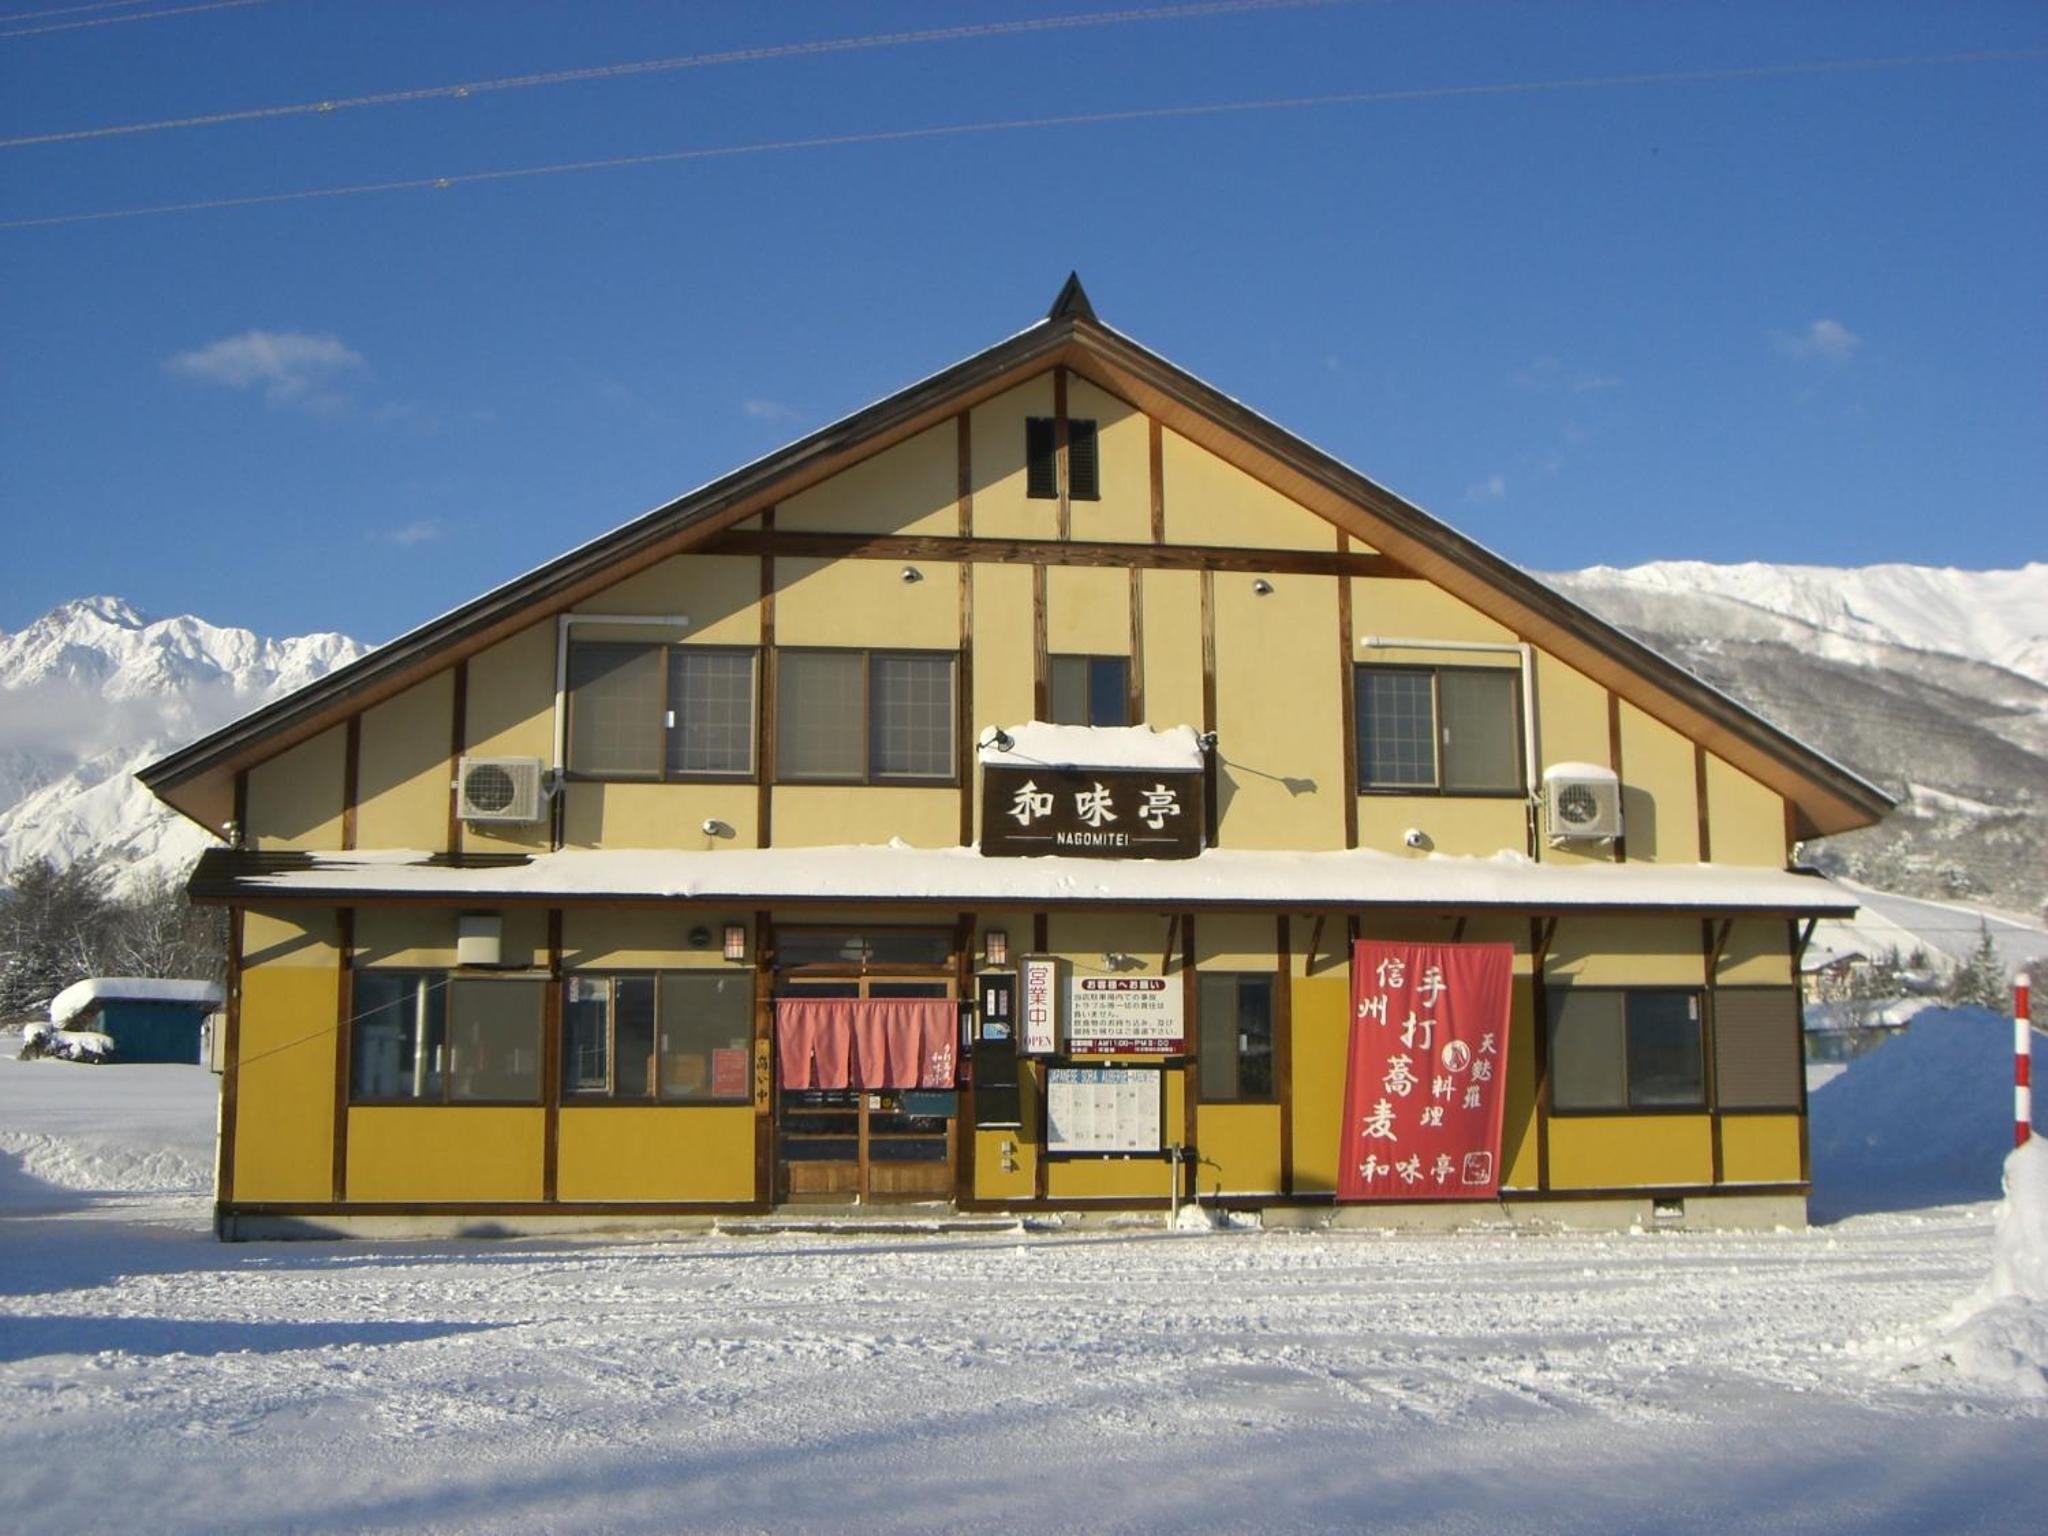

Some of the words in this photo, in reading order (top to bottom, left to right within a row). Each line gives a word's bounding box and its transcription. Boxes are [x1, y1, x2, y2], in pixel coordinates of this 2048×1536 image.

[1006, 779, 1181, 830] 和味亭
[1056, 831, 1129, 847] NAGOMITEI
[1028, 967, 1048, 1026] 営業中
[1357, 957, 1406, 1027] 信州
[1023, 1036, 1052, 1047] OPEN
[1361, 966, 1447, 1142] 手打蕎麦
[1420, 1075, 1456, 1127] 料理
[1359, 1153, 1455, 1184] 和味亭
